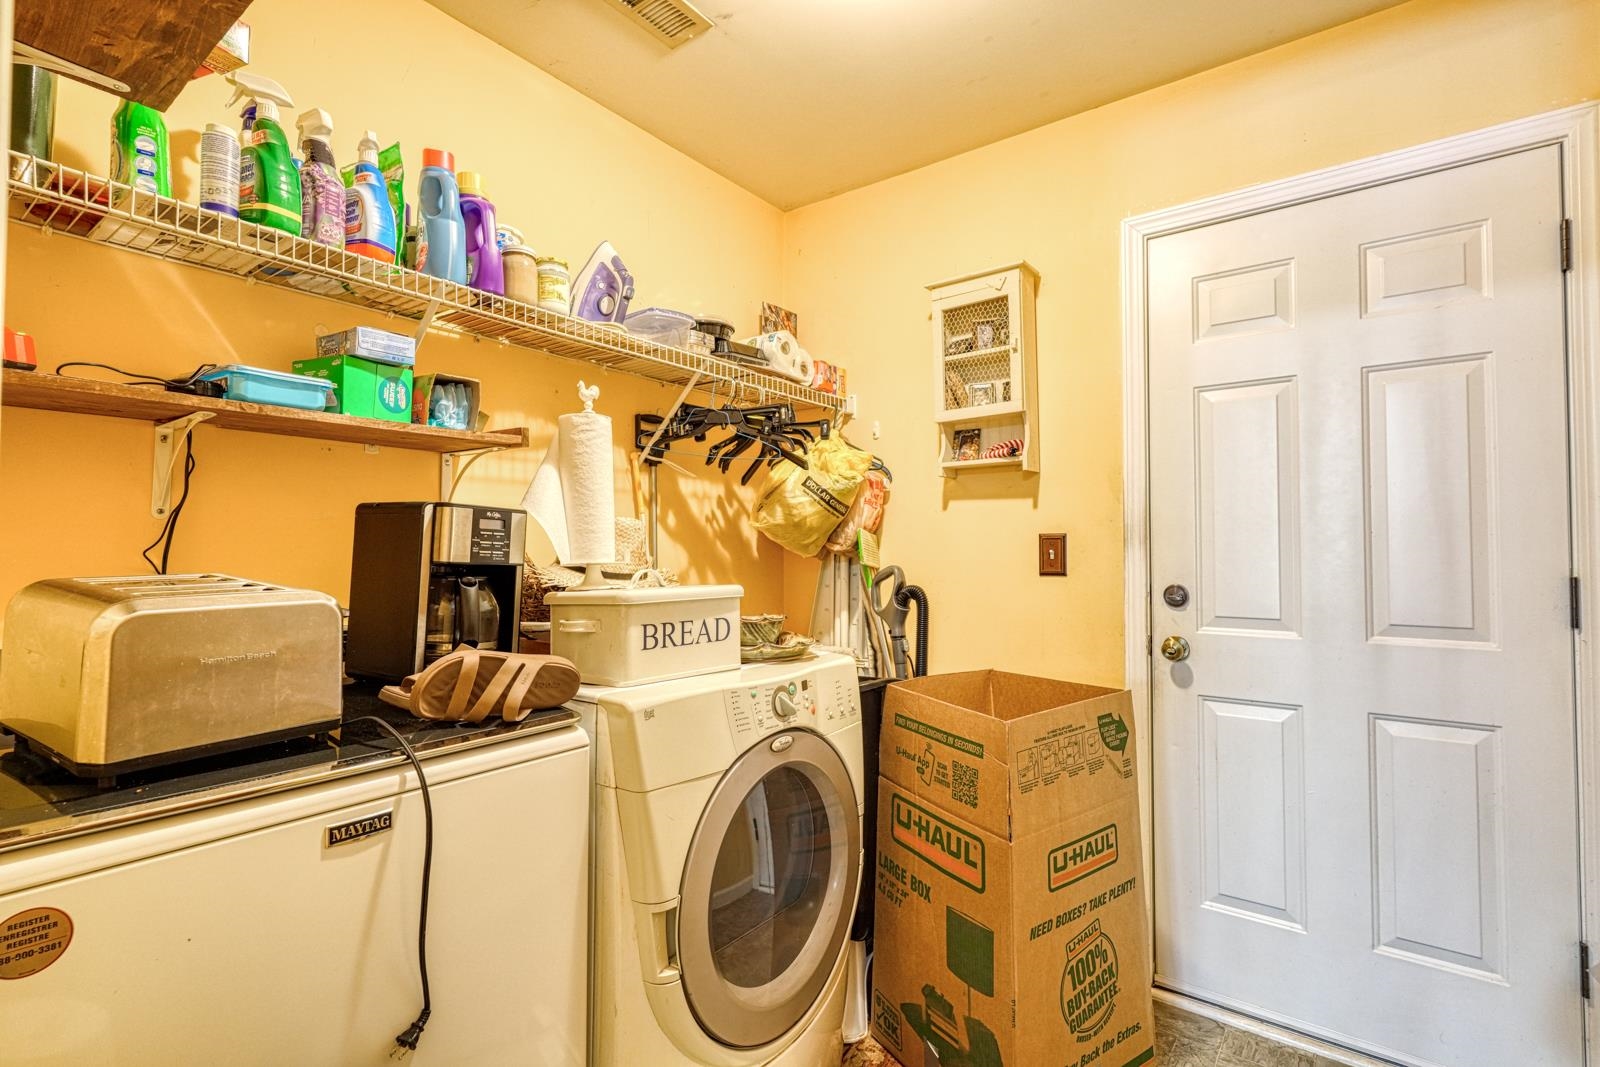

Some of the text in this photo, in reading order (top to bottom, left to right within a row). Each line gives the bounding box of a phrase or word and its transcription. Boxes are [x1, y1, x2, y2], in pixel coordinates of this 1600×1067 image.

[806, 479, 831, 502] DOLLAR
[641, 617, 731, 651] BREAD
[906, 720, 918, 730] YOUR
[918, 724, 947, 743] BELONGINGS
[947, 735, 954, 745] IN
[954, 739, 983, 756] SECONDS!
[896, 745, 930, 769] U-Haul App
[331, 815, 390, 842] MAYTAG
[896, 802, 978, 869] U-HAUL
[1053, 832, 1114, 874] U-HAUL
[879, 850, 931, 904] LARGE BOX
[7, 914, 50, 932] REGISTER
[1030, 877, 1136, 941] NEED BOXES? TAKE PLENTY!
[6, 932, 50, 951] REGISTRE
[1068, 923, 1099, 953] U-HAUL
[1067, 939, 1108, 991] 100%
[1066, 962, 1116, 1018] BUY-BACK
[1080, 1022, 1142, 1067] Back the Extras.
